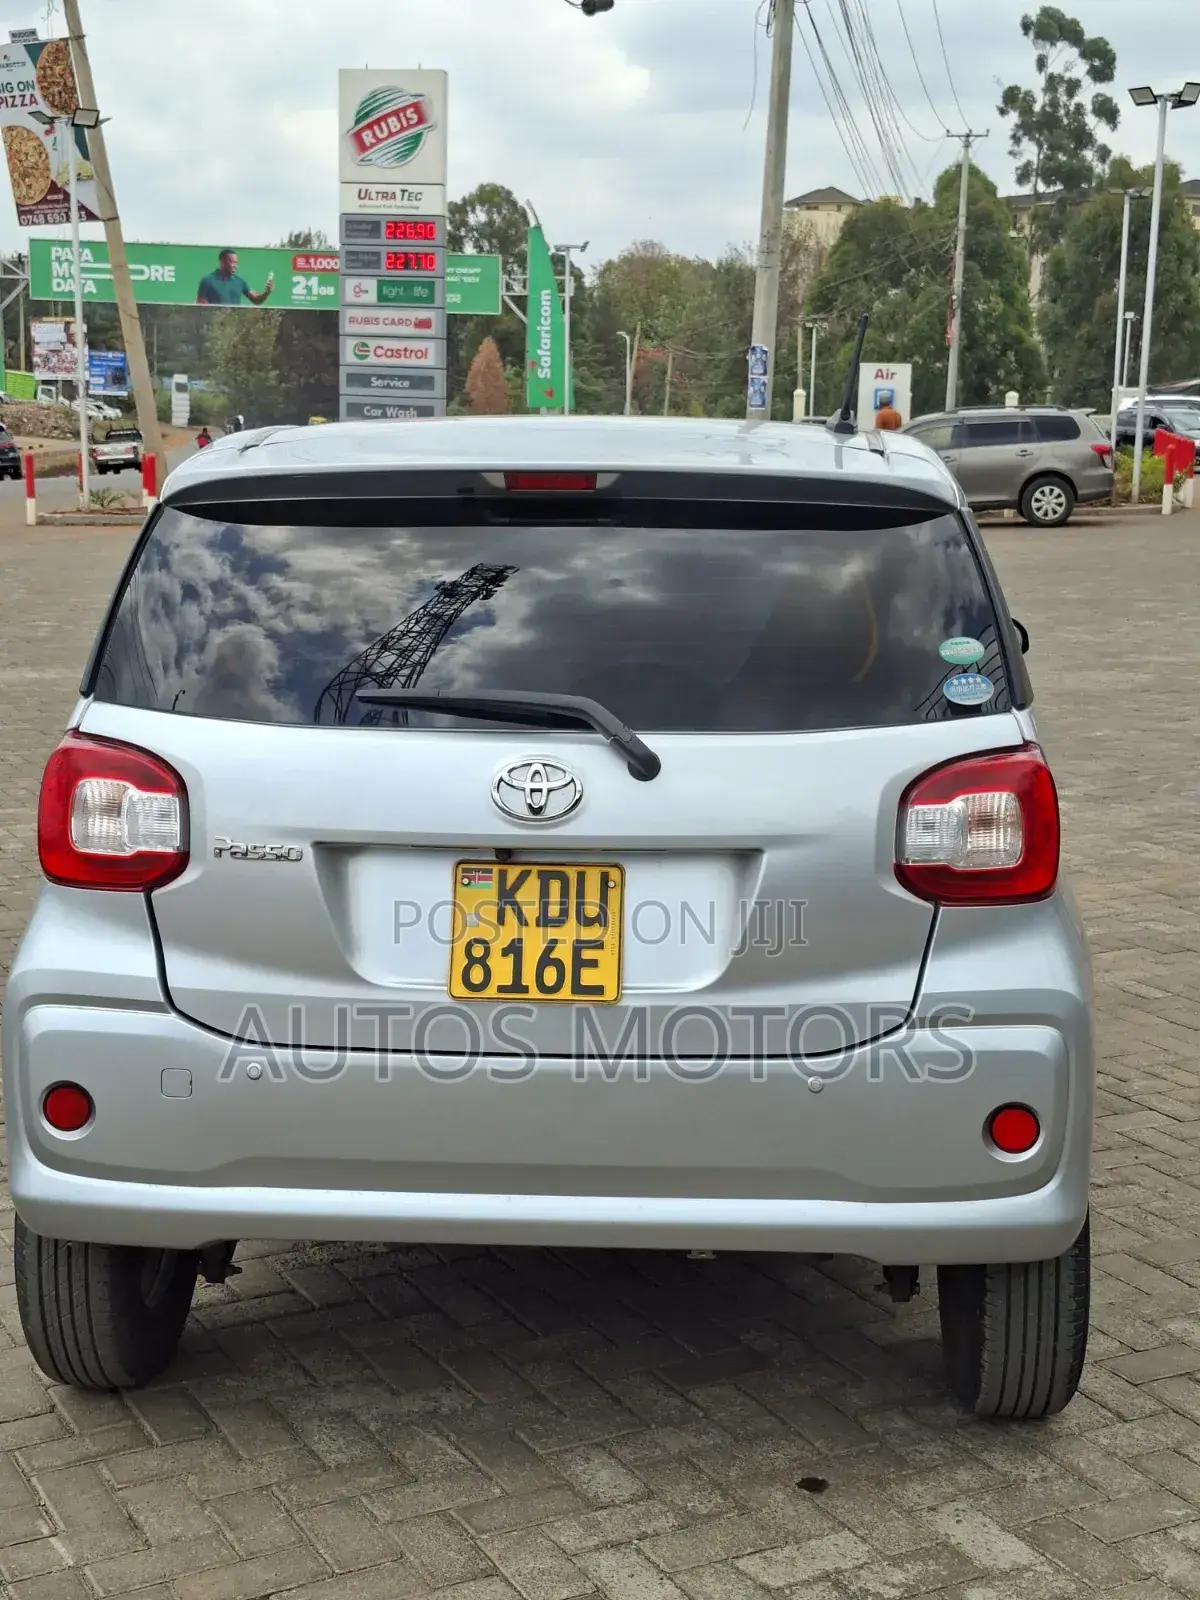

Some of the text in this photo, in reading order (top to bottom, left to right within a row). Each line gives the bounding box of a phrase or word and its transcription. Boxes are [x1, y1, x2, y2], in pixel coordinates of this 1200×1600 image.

[17, 80, 35, 92] ON
[0, 94, 38, 109] PIZZA
[357, 188, 423, 202] ULTRA TEC
[386, 253, 436, 270] 227.70
[348, 316, 412, 327] RUBIS CARD
[537, 289, 552, 379] Safaricom
[373, 345, 429, 360] Castrol
[371, 375, 411, 388] Service
[874, 368, 898, 381] Air
[363, 406, 418, 418] Car Wash
[497, 869, 610, 928] KDU
[461, 937, 605, 996] 816E
